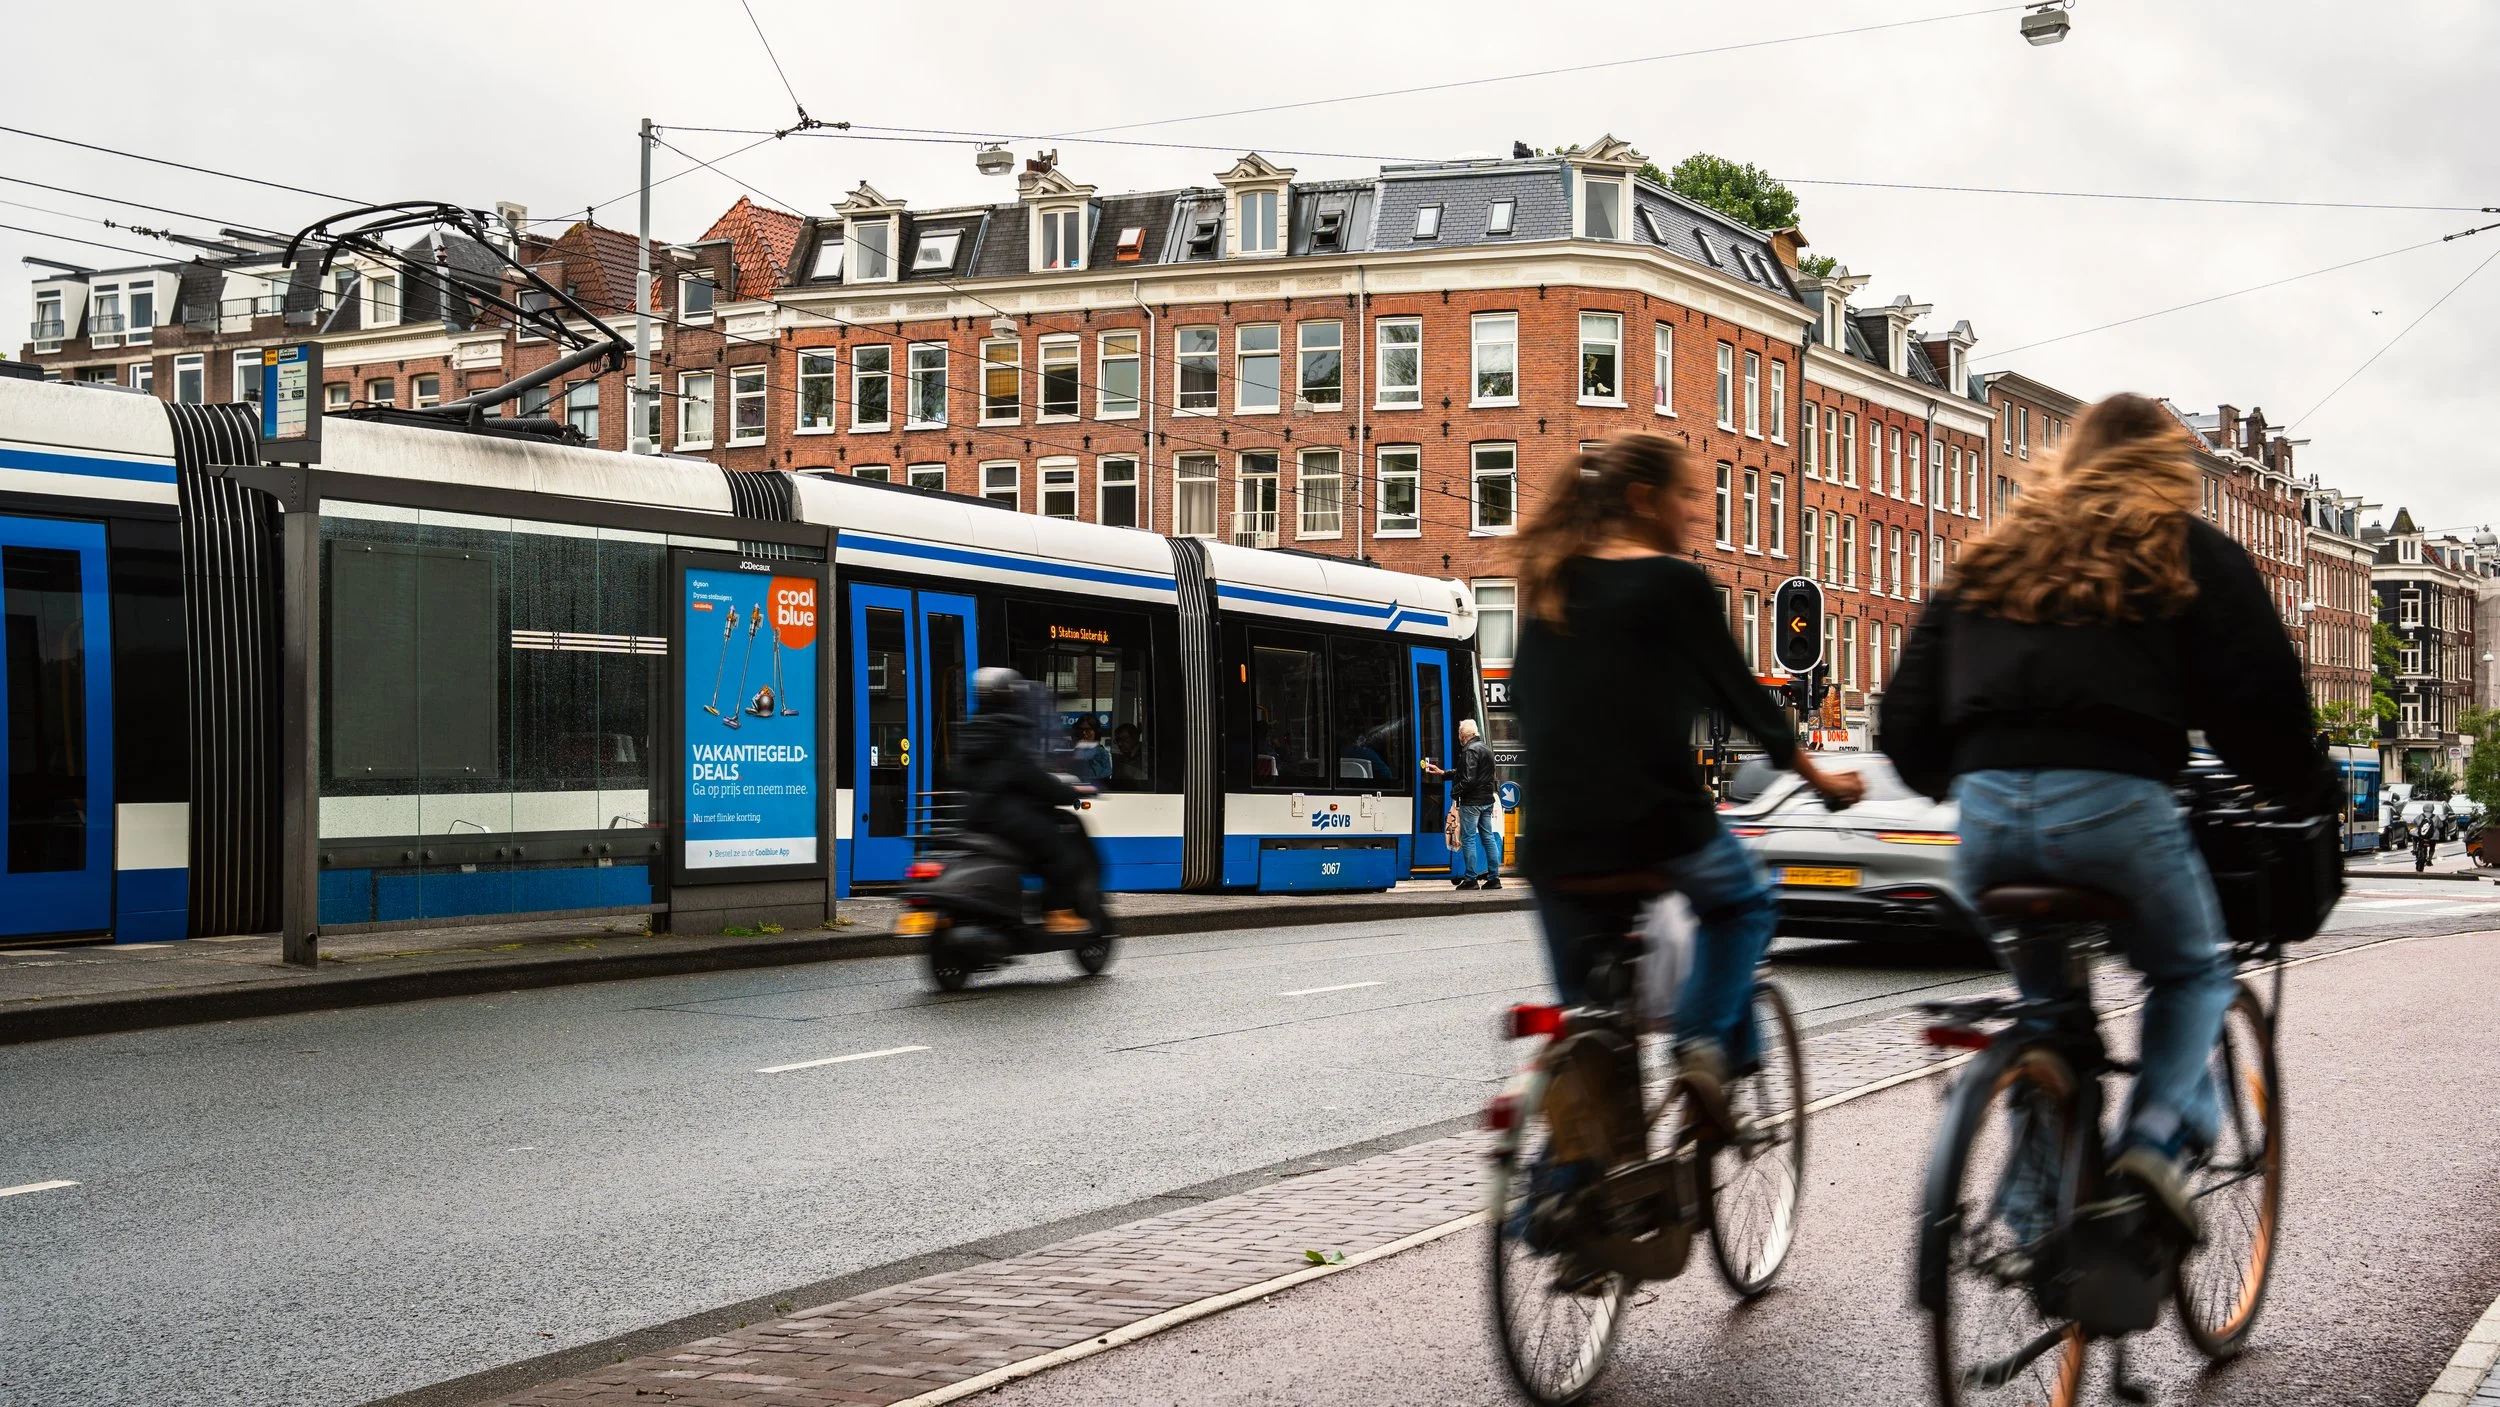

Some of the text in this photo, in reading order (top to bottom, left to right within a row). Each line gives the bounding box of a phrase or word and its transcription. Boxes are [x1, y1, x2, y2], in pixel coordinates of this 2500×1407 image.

[740, 561, 770, 571] JCDecaux
[693, 580, 709, 588] dyson
[778, 588, 814, 607] cool
[778, 605, 814, 627] blue
[1050, 625, 1109, 643] 9 Station Sloterdijk
[692, 744, 808, 762] VAKANTIEGELD-
[1494, 754, 1518, 762] COPY
[692, 783, 808, 798] Ga op prijs en neem mee.
[693, 812, 761, 824] Nu met flinke korting
[1331, 814, 1351, 828] GVB
[755, 848, 778, 857] Coolblue
[779, 848, 790, 857] App
[1321, 862, 1341, 875] 3067
